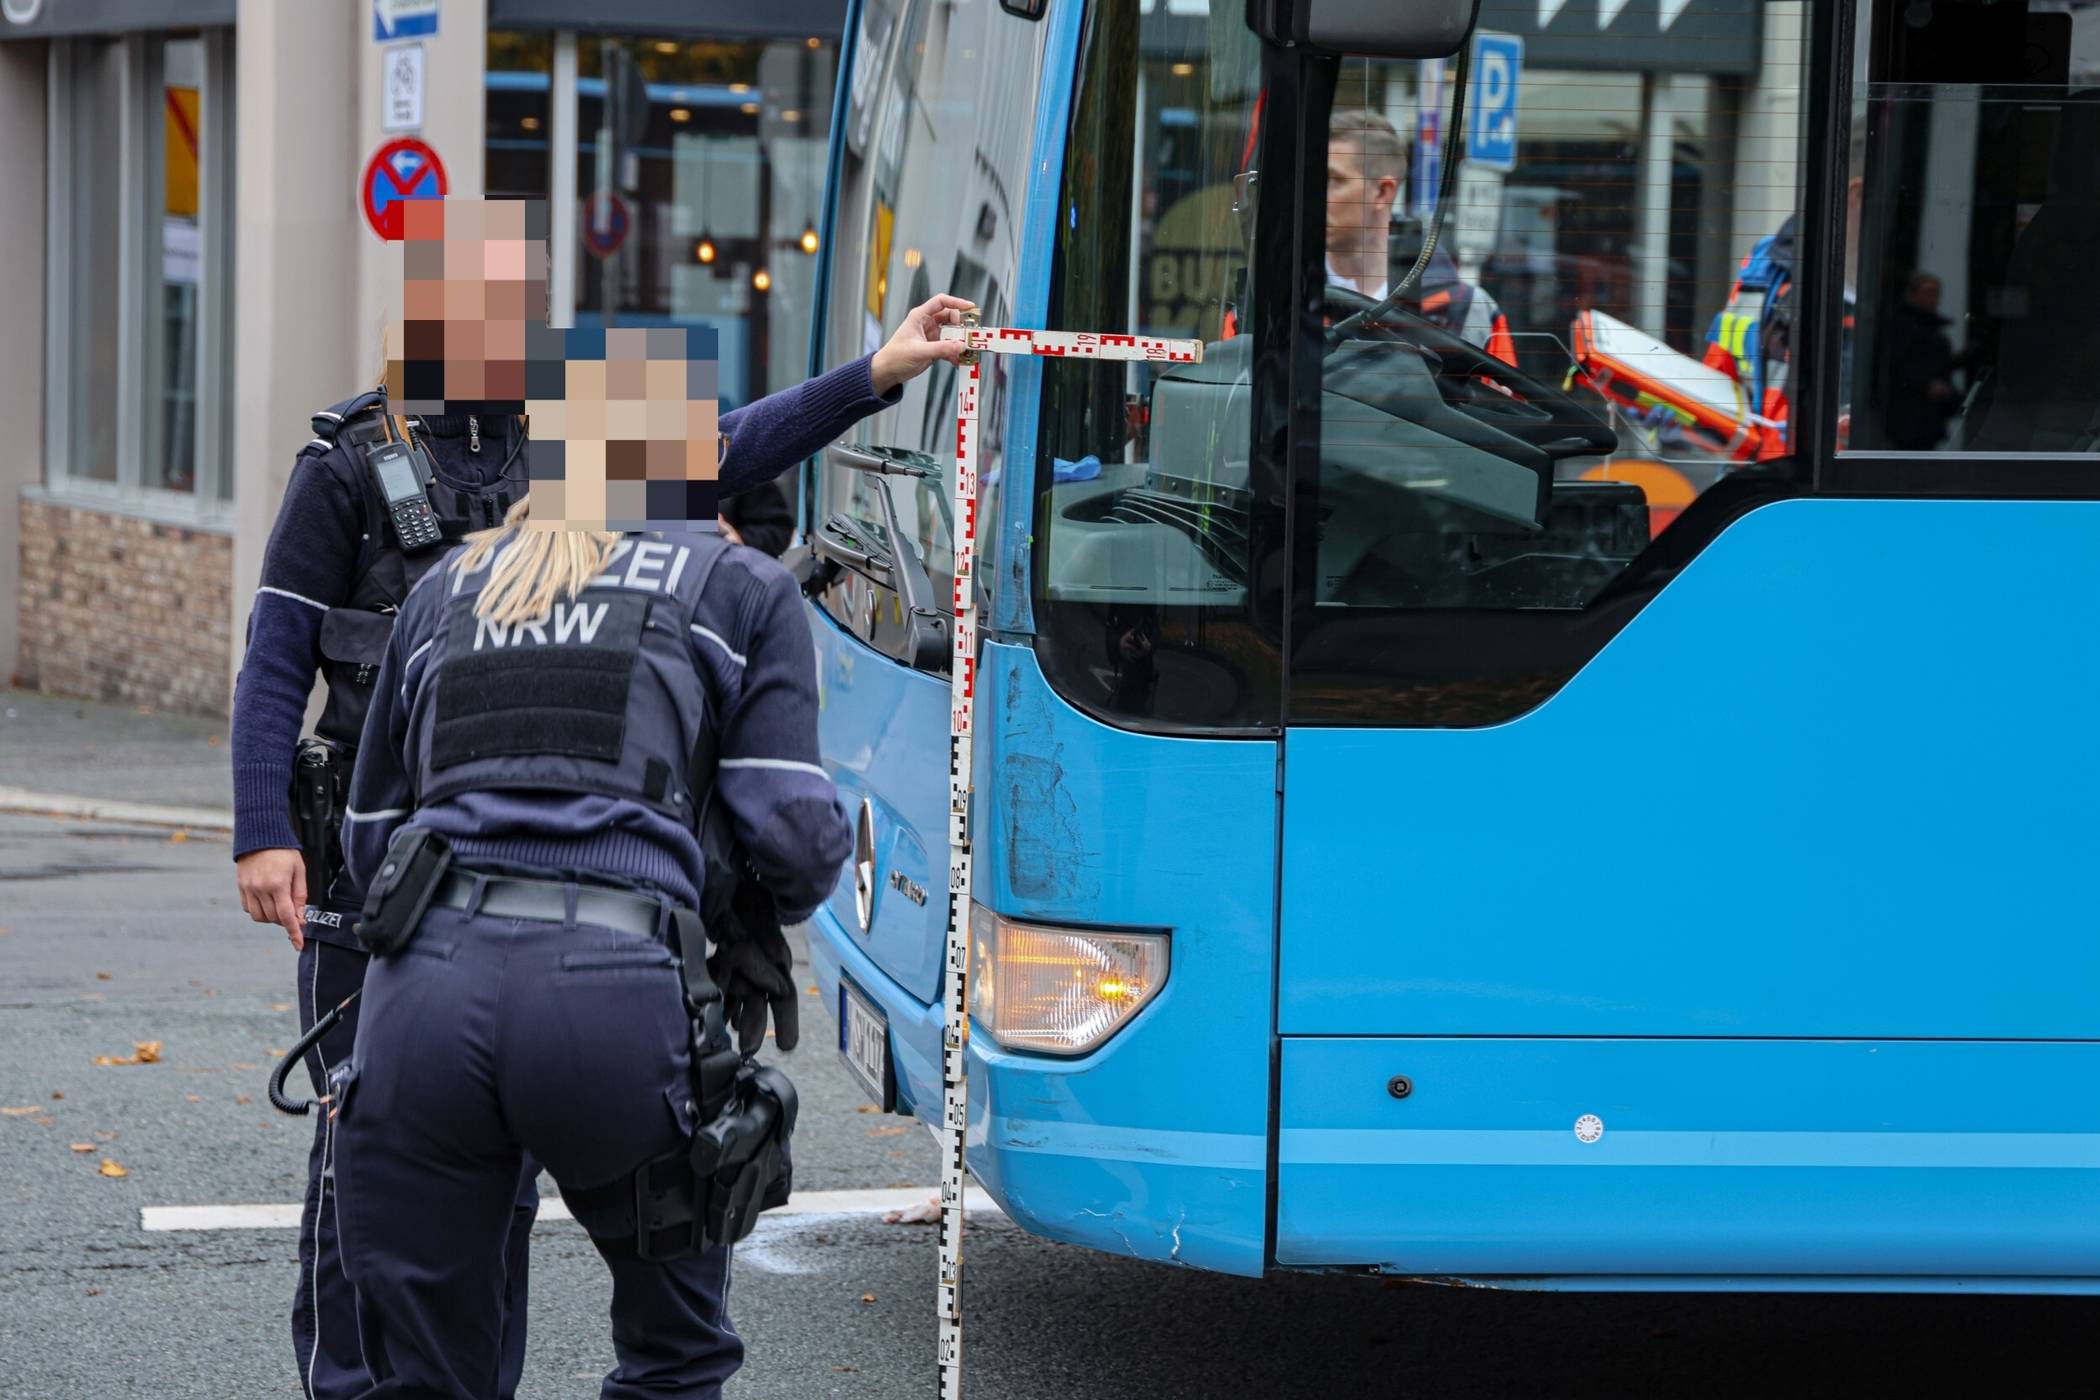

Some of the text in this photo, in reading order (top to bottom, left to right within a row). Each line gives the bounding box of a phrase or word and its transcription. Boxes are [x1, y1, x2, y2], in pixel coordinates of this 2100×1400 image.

[1477, 50, 1510, 149] P
[1077, 333, 1097, 346] 19
[1146, 348, 1167, 360] 18
[959, 391, 969, 414] 14
[965, 472, 976, 495] 13
[451, 540, 690, 597] PZEI
[956, 551, 965, 571] 12
[473, 602, 609, 651] NRW
[964, 631, 973, 654] 11
[953, 710, 963, 732] 10
[950, 867, 961, 889] 08
[955, 946, 966, 969] 07
[953, 1103, 964, 1126] 05
[941, 1181, 951, 1204] 04
[940, 1338, 950, 1362] 02
